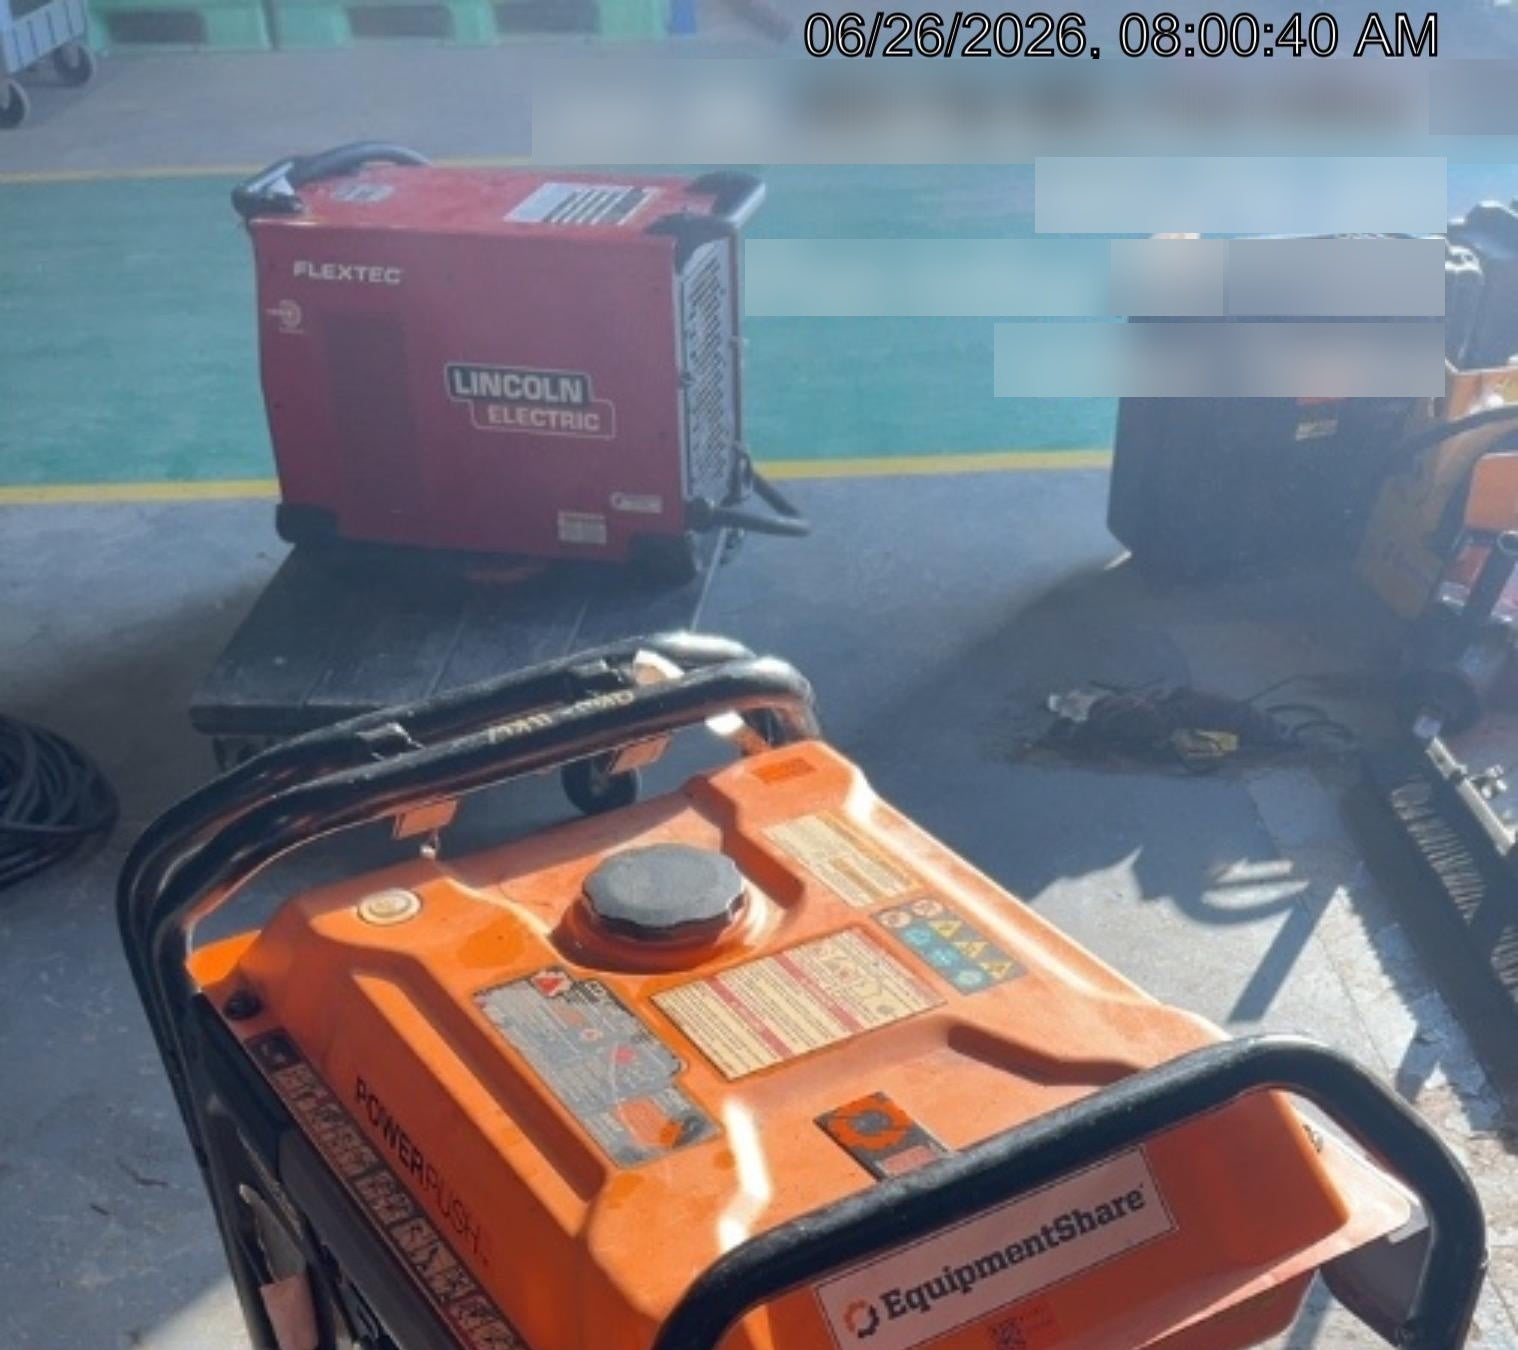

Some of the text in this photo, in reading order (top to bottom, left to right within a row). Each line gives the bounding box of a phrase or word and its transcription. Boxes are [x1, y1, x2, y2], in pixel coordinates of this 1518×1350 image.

[292, 259, 403, 286] FLEXTEC
[452, 368, 585, 404] LINCOLN
[487, 404, 600, 431] ELECTRIC
[879, 1186, 1146, 1321] EquipmentShare
